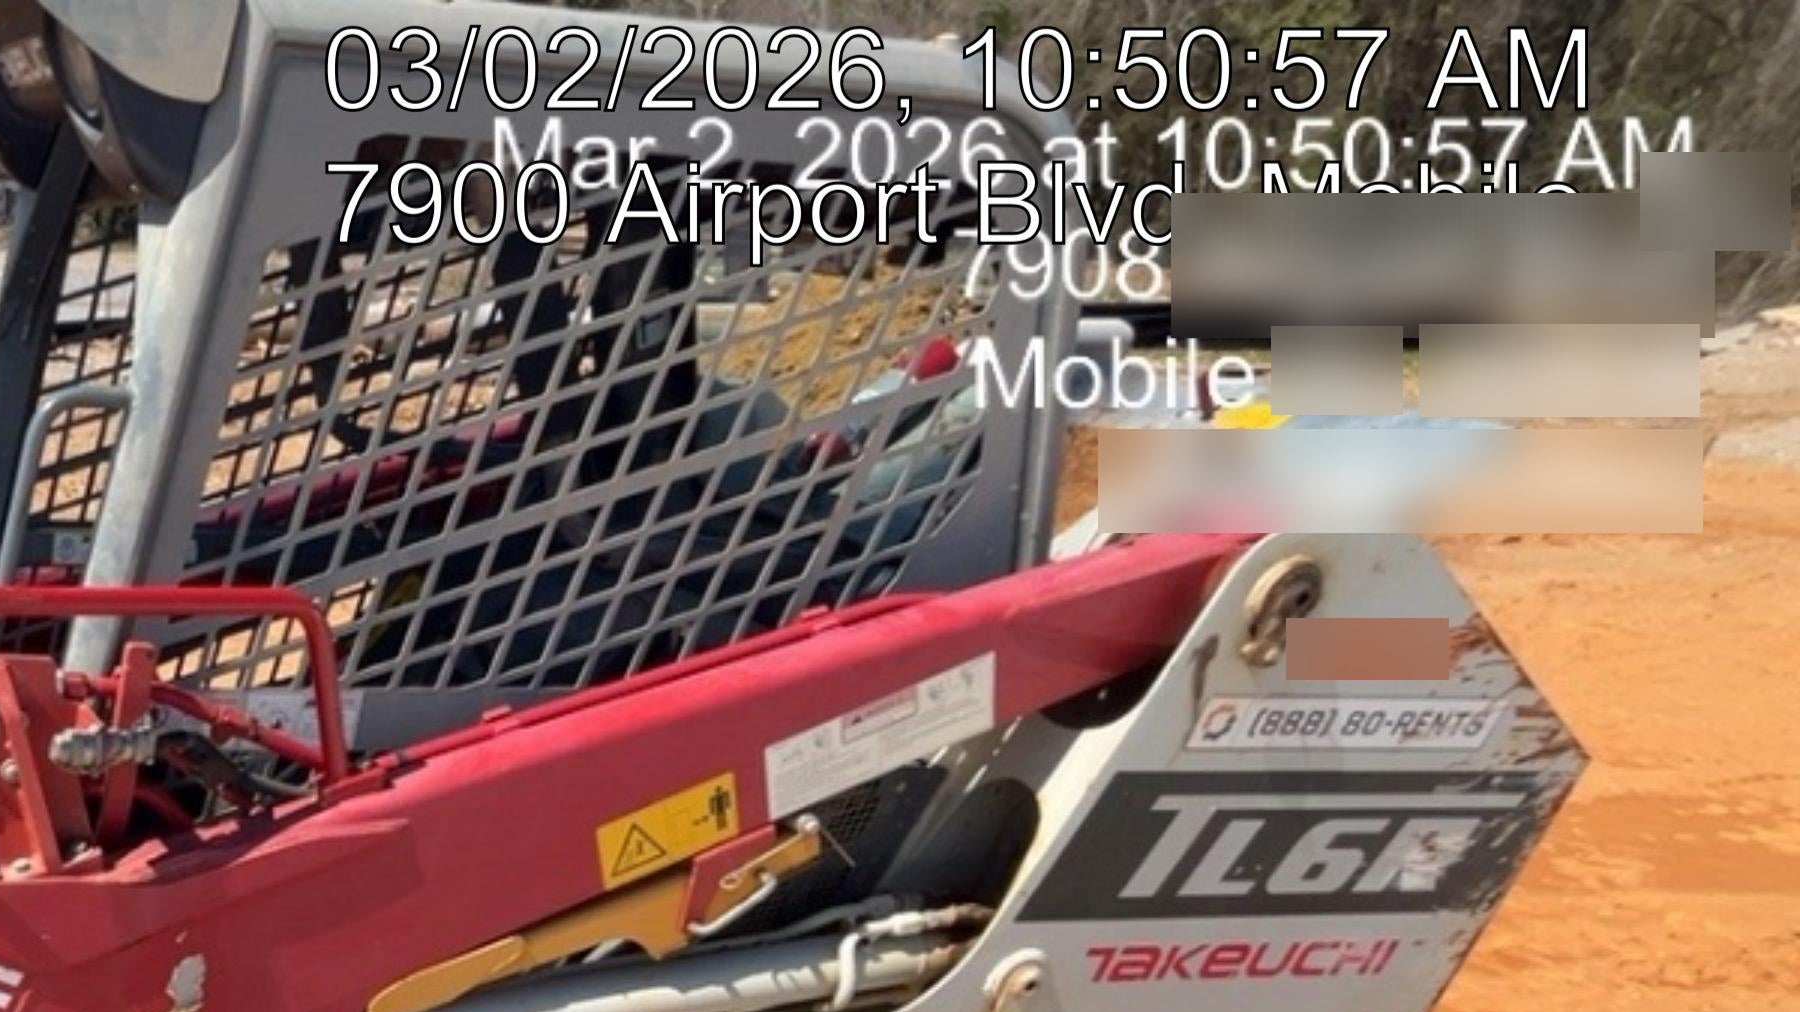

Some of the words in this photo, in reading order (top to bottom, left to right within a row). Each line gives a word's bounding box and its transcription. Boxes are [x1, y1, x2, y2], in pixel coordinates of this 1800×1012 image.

[1247, 706, 1338, 739] (888)
[1340, 709, 1486, 738] 80-RENTS
[1085, 939, 1399, 984] TAKEUCHI
